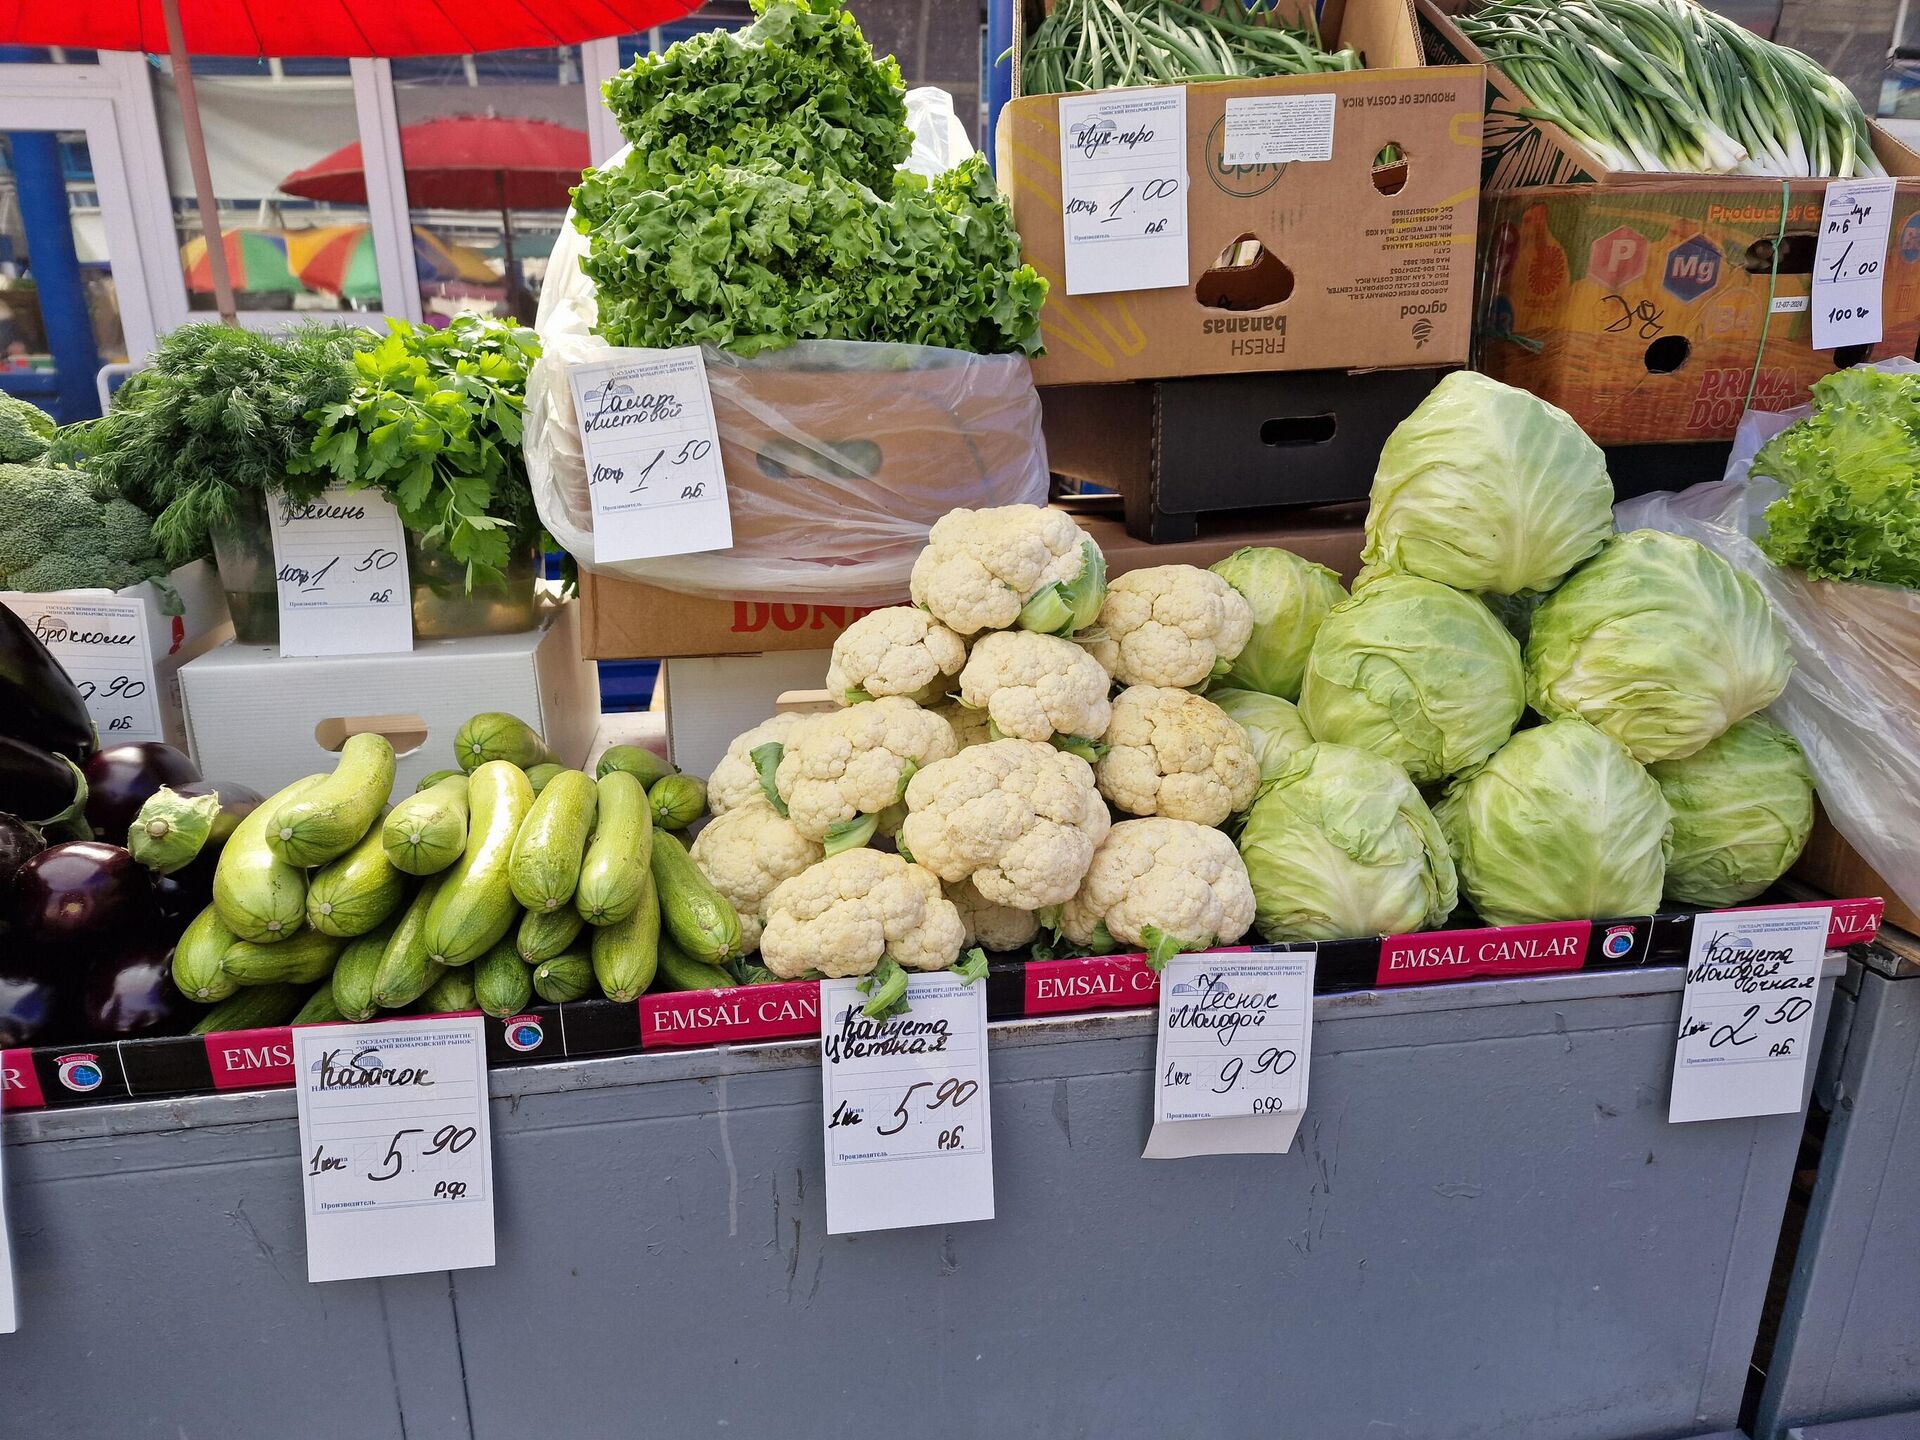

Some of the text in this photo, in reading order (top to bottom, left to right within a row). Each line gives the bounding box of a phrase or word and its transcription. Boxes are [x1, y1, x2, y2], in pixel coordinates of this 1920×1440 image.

[1341, 91, 1456, 109] PRODUCE OF COSTA RICA
[1414, 240, 1451, 248] CAVENDISH
[1607, 239, 1637, 273] P
[1671, 255, 1715, 283] Mg
[1366, 291, 1397, 299] COMPANY
[1400, 300, 1448, 320] agrood
[1202, 315, 1287, 337] bananas
[1230, 336, 1286, 357] FRESH
[1695, 366, 1799, 400] PRIMA
[1829, 915, 1879, 935] NLA
[1388, 944, 1471, 970] EMSAL
[1477, 935, 1580, 962] CANLAR
[1036, 973, 1123, 999] EMSAL
[653, 998, 818, 1033] EMSAL CAN
[839, 1151, 888, 1161] Производитель
[320, 1199, 376, 1210] Производитель
